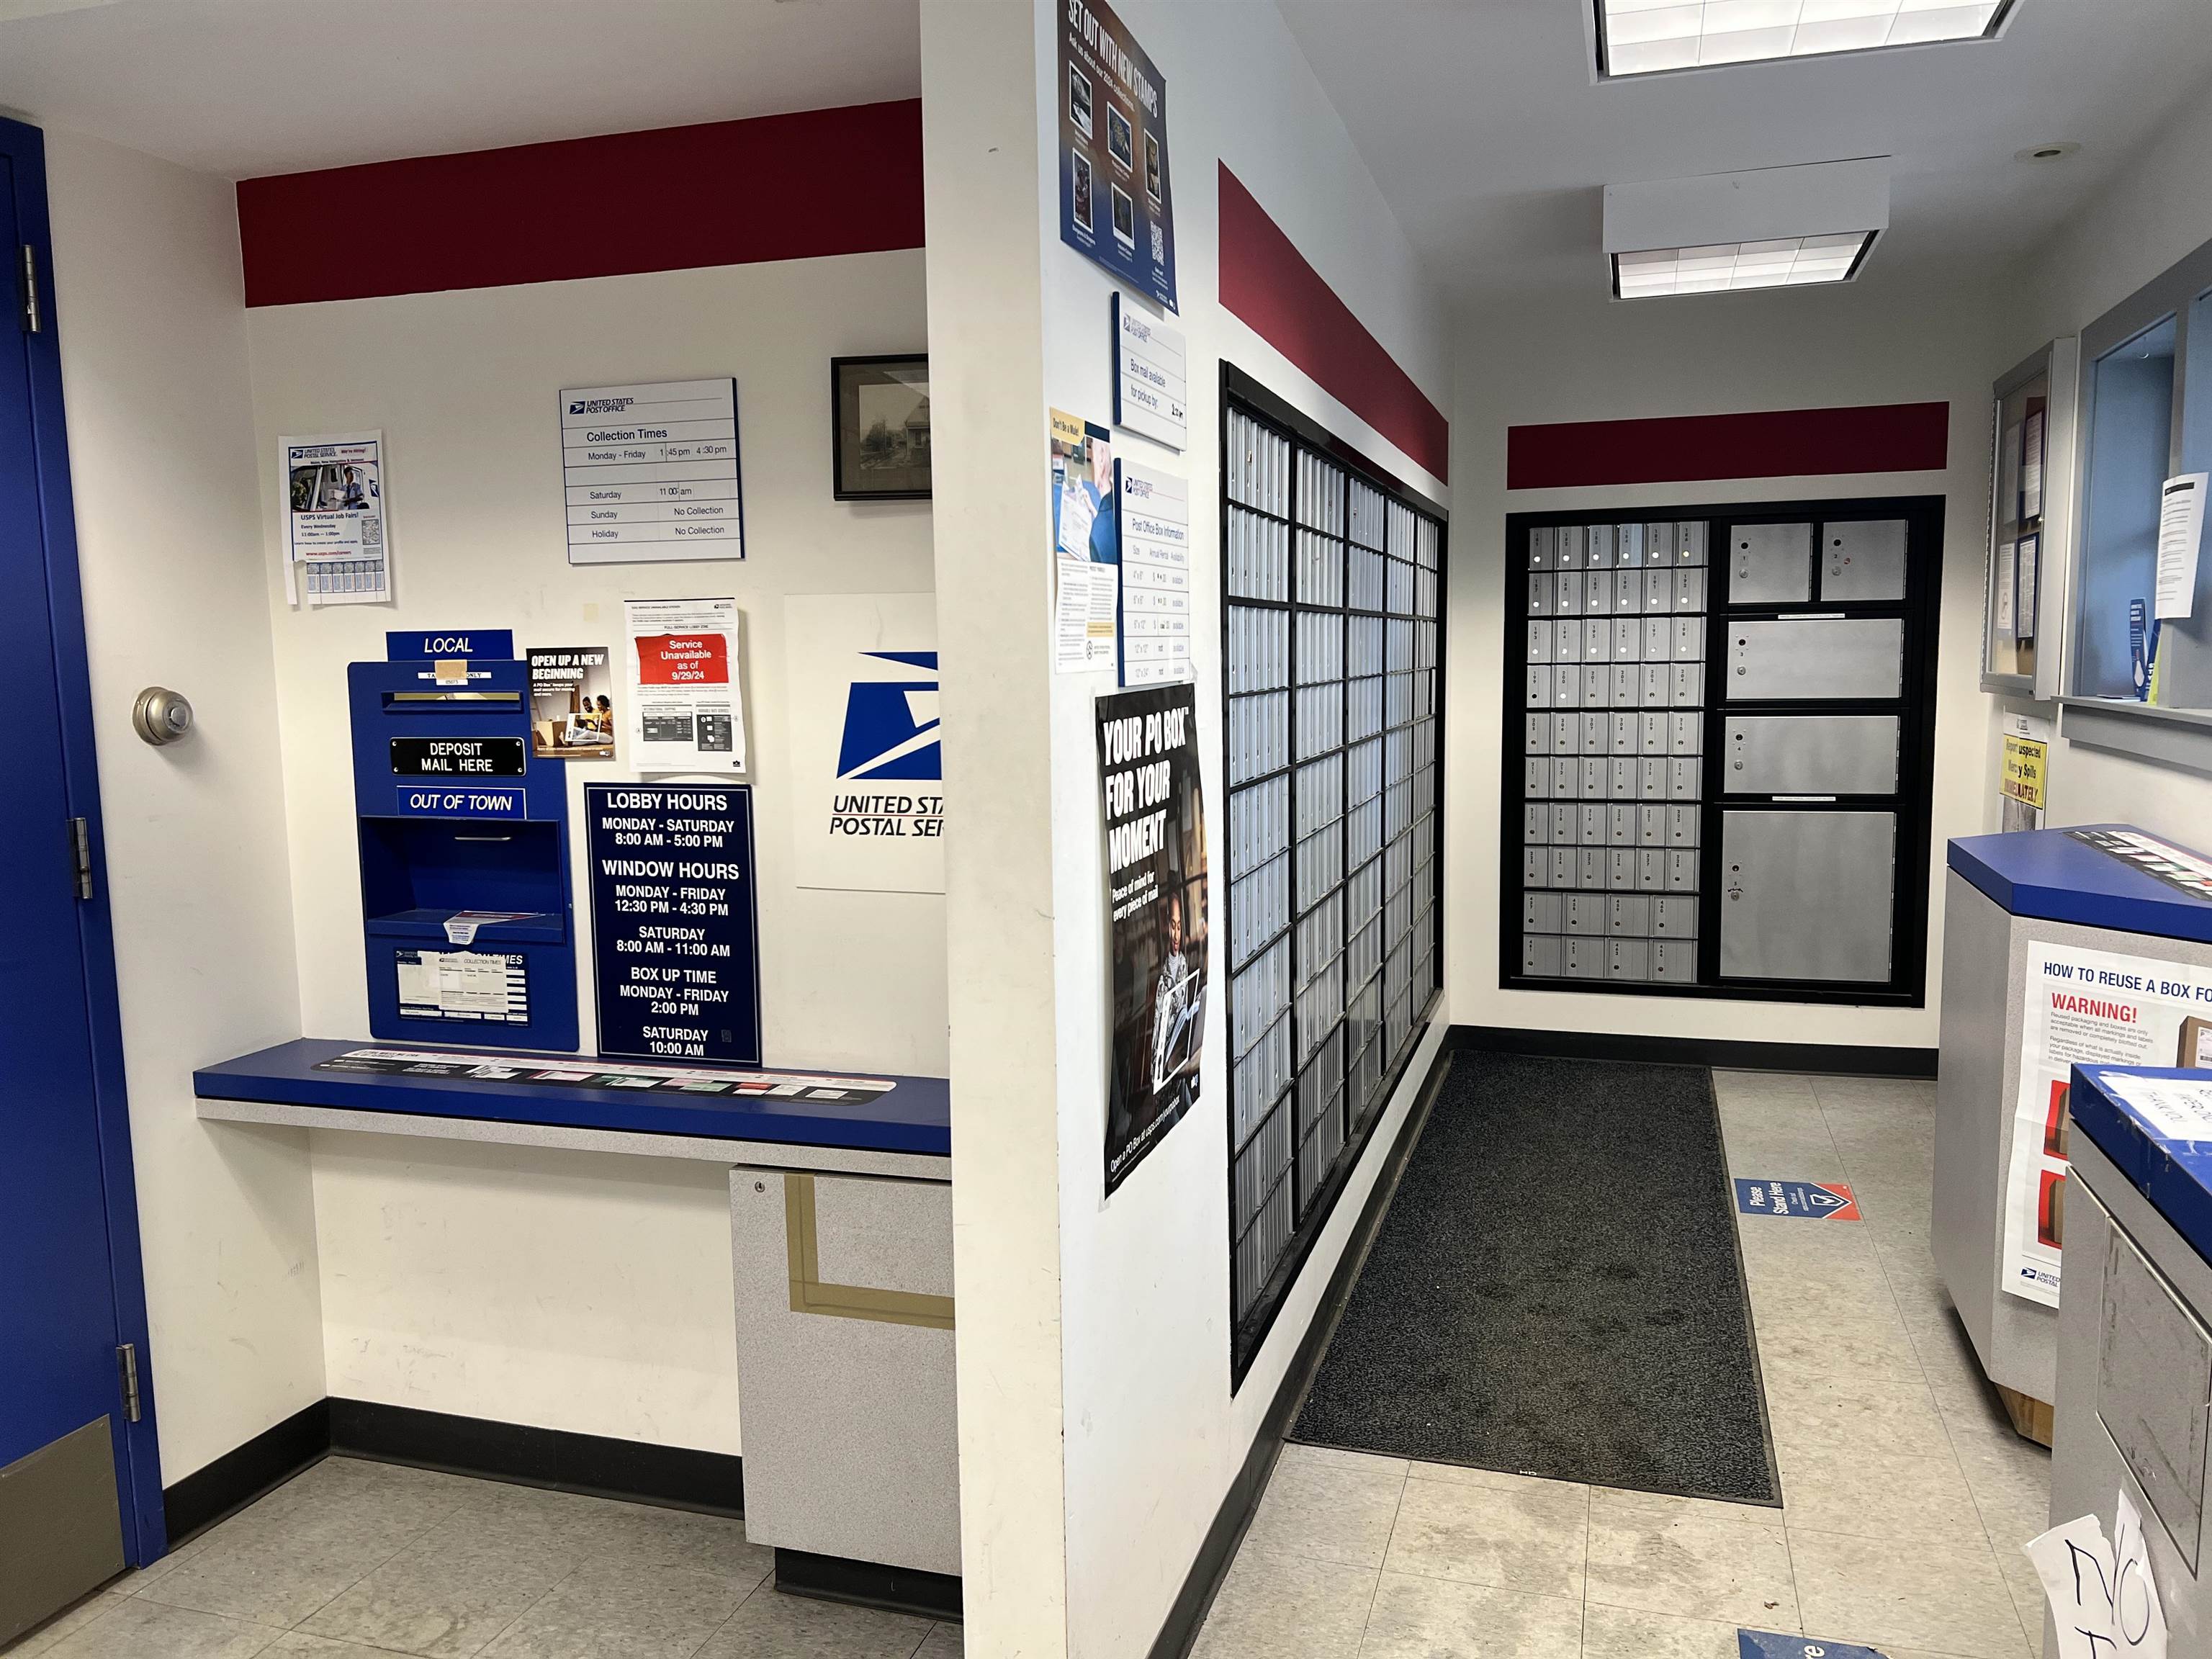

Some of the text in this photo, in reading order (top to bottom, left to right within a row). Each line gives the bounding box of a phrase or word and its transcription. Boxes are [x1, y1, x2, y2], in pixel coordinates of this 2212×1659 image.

[1069, 0, 1158, 119] SET OUT WITH NEW STAMPS
[1130, 359, 1166, 387] Box mail available
[587, 399, 611, 408] UNITED
[1138, 390, 1151, 407] pickup
[587, 428, 667, 442] Collection Times
[588, 452, 616, 461] Monday
[624, 451, 646, 459] Friday
[715, 446, 727, 455] pm
[590, 491, 621, 500] Saturday
[591, 511, 618, 520] Sunday
[687, 506, 724, 515] Collection
[592, 530, 619, 539] Holiday
[1133, 518, 1142, 531] Post
[1143, 521, 1155, 534] Office
[1164, 526, 1184, 540] Information
[424, 637, 473, 652] LOCAL
[670, 640, 702, 649] Service
[531, 654, 604, 667] OPEN UP A NEW
[661, 650, 711, 660] Unavailable
[532, 667, 584, 680] BEGINNING
[672, 671, 704, 680] 9/29/24
[1103, 716, 1142, 766] YOUR
[1145, 711, 1162, 756] PO
[430, 743, 482, 755] DEPOSIT
[421, 759, 493, 772] MAIL HERE
[1105, 760, 1171, 821] FOR YOUR
[410, 793, 512, 811] OUT OF TOWN
[607, 792, 727, 811] LOBBY HOURS
[833, 796, 912, 814] UNITED
[602, 817, 734, 832] MONDAY SATURDAY
[830, 817, 907, 836] POSTAL
[615, 833, 723, 848] 8:00 AM 5:00 PM
[1109, 809, 1166, 874] MOMENT
[602, 860, 739, 880] WINDOW HOURS
[616, 885, 726, 900] MONDAY FRIDAY
[1112, 886, 1128, 904] Peace
[1128, 878, 1134, 894] of
[1134, 872, 1147, 891] mind
[615, 900, 729, 916] 12:30 PM 4:30 PM
[1112, 904, 1128, 922] every
[1127, 896, 1142, 917] piece
[1142, 889, 1148, 905] of
[639, 926, 705, 940] SATURDAY
[616, 940, 730, 957] 8:00 AM 11:00 AM
[631, 967, 716, 984] BOX UP TIME
[2044, 962, 2212, 1003] HOW TO REUSE A BOX FO
[620, 985, 729, 1002] MONDAY FRIDAY
[651, 1002, 698, 1015] 2:00 PM
[2051, 992, 2137, 1023] WARNING!
[2071, 1016, 2098, 1026] packaging
[642, 1026, 709, 1041] SATURDAY
[2102, 1029, 2125, 1038] markings
[649, 1041, 704, 1056] 10:00 AM
[1110, 1153, 1122, 1173] Open
[1122, 1151, 1125, 1161] a
[1125, 1141, 1133, 1157] PO
[1141, 1128, 1146, 1141] at
[1750, 1187, 1766, 1206] Please
[1768, 1182, 1789, 1215] Stand Here
[2037, 1276, 2058, 1287] POSTAL
[2038, 1271, 2060, 1282] UNITED
